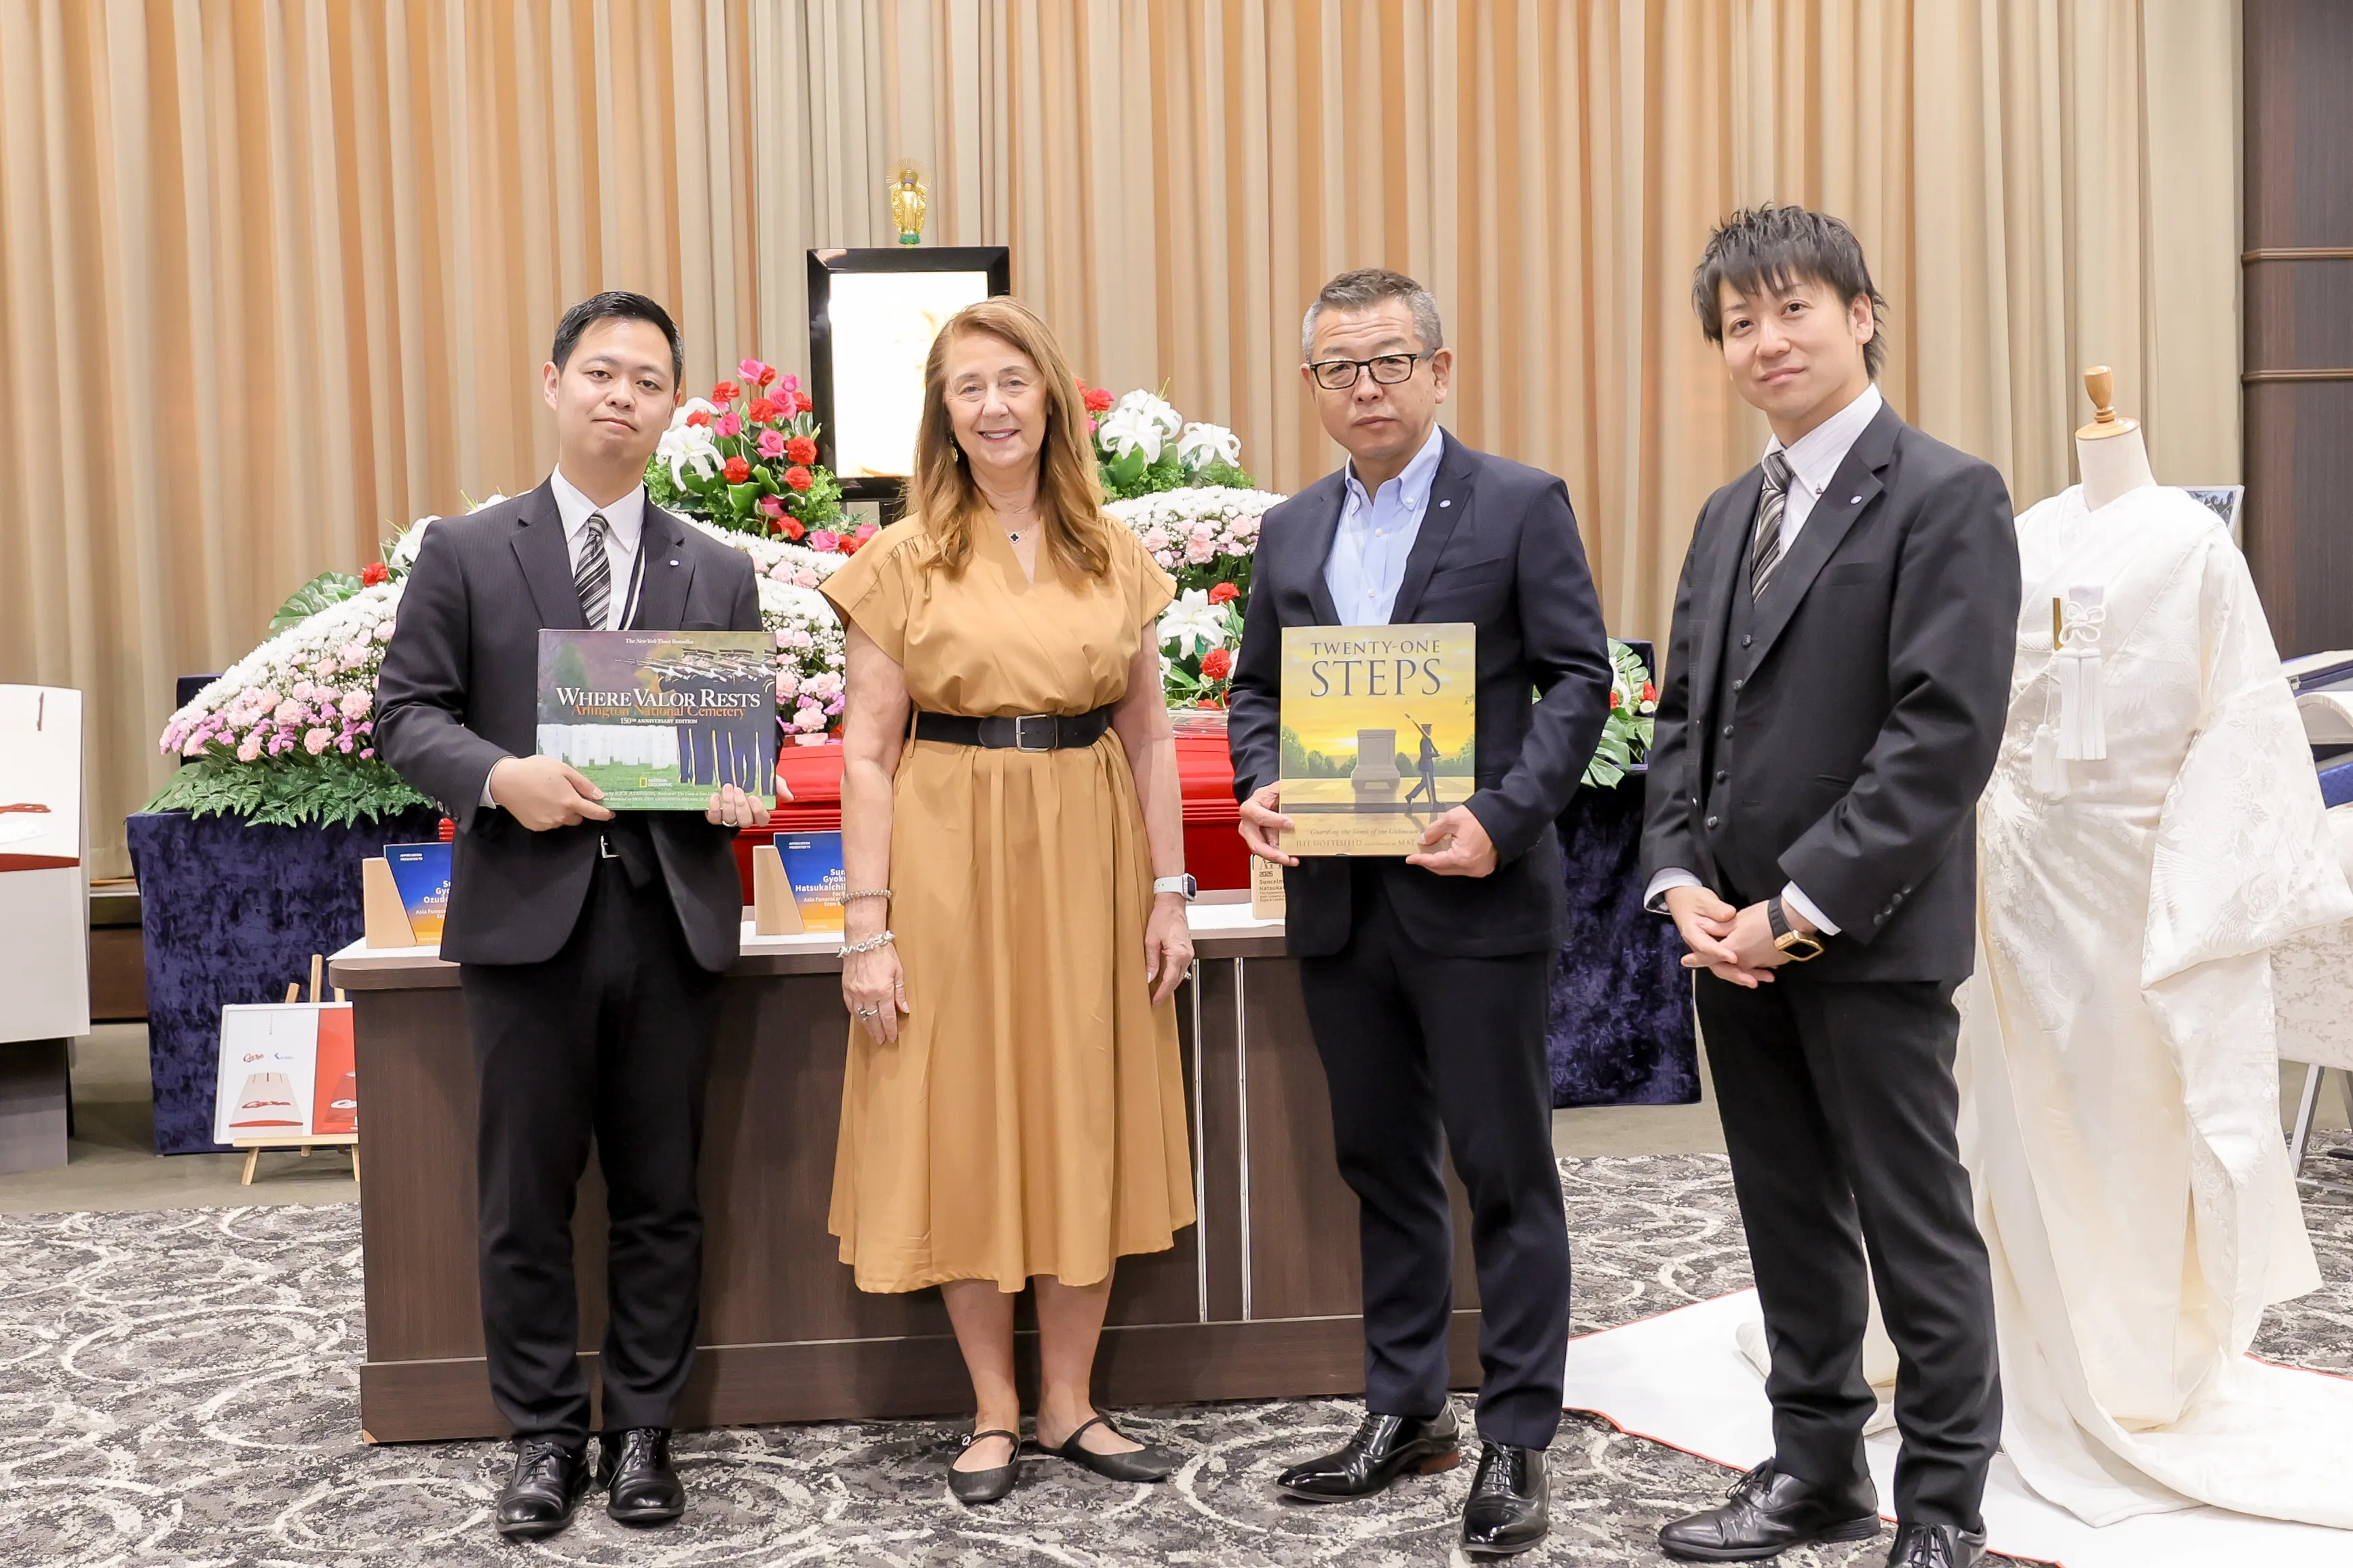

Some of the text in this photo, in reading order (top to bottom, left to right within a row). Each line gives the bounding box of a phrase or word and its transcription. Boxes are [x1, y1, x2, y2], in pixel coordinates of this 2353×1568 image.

[1311, 640, 1440, 655] TWENTY-ONE
[1311, 658, 1441, 697] STEPS
[556, 687, 761, 708] WHERE VALOR RESTS
[571, 704, 745, 720] Arlington National Cemetery
